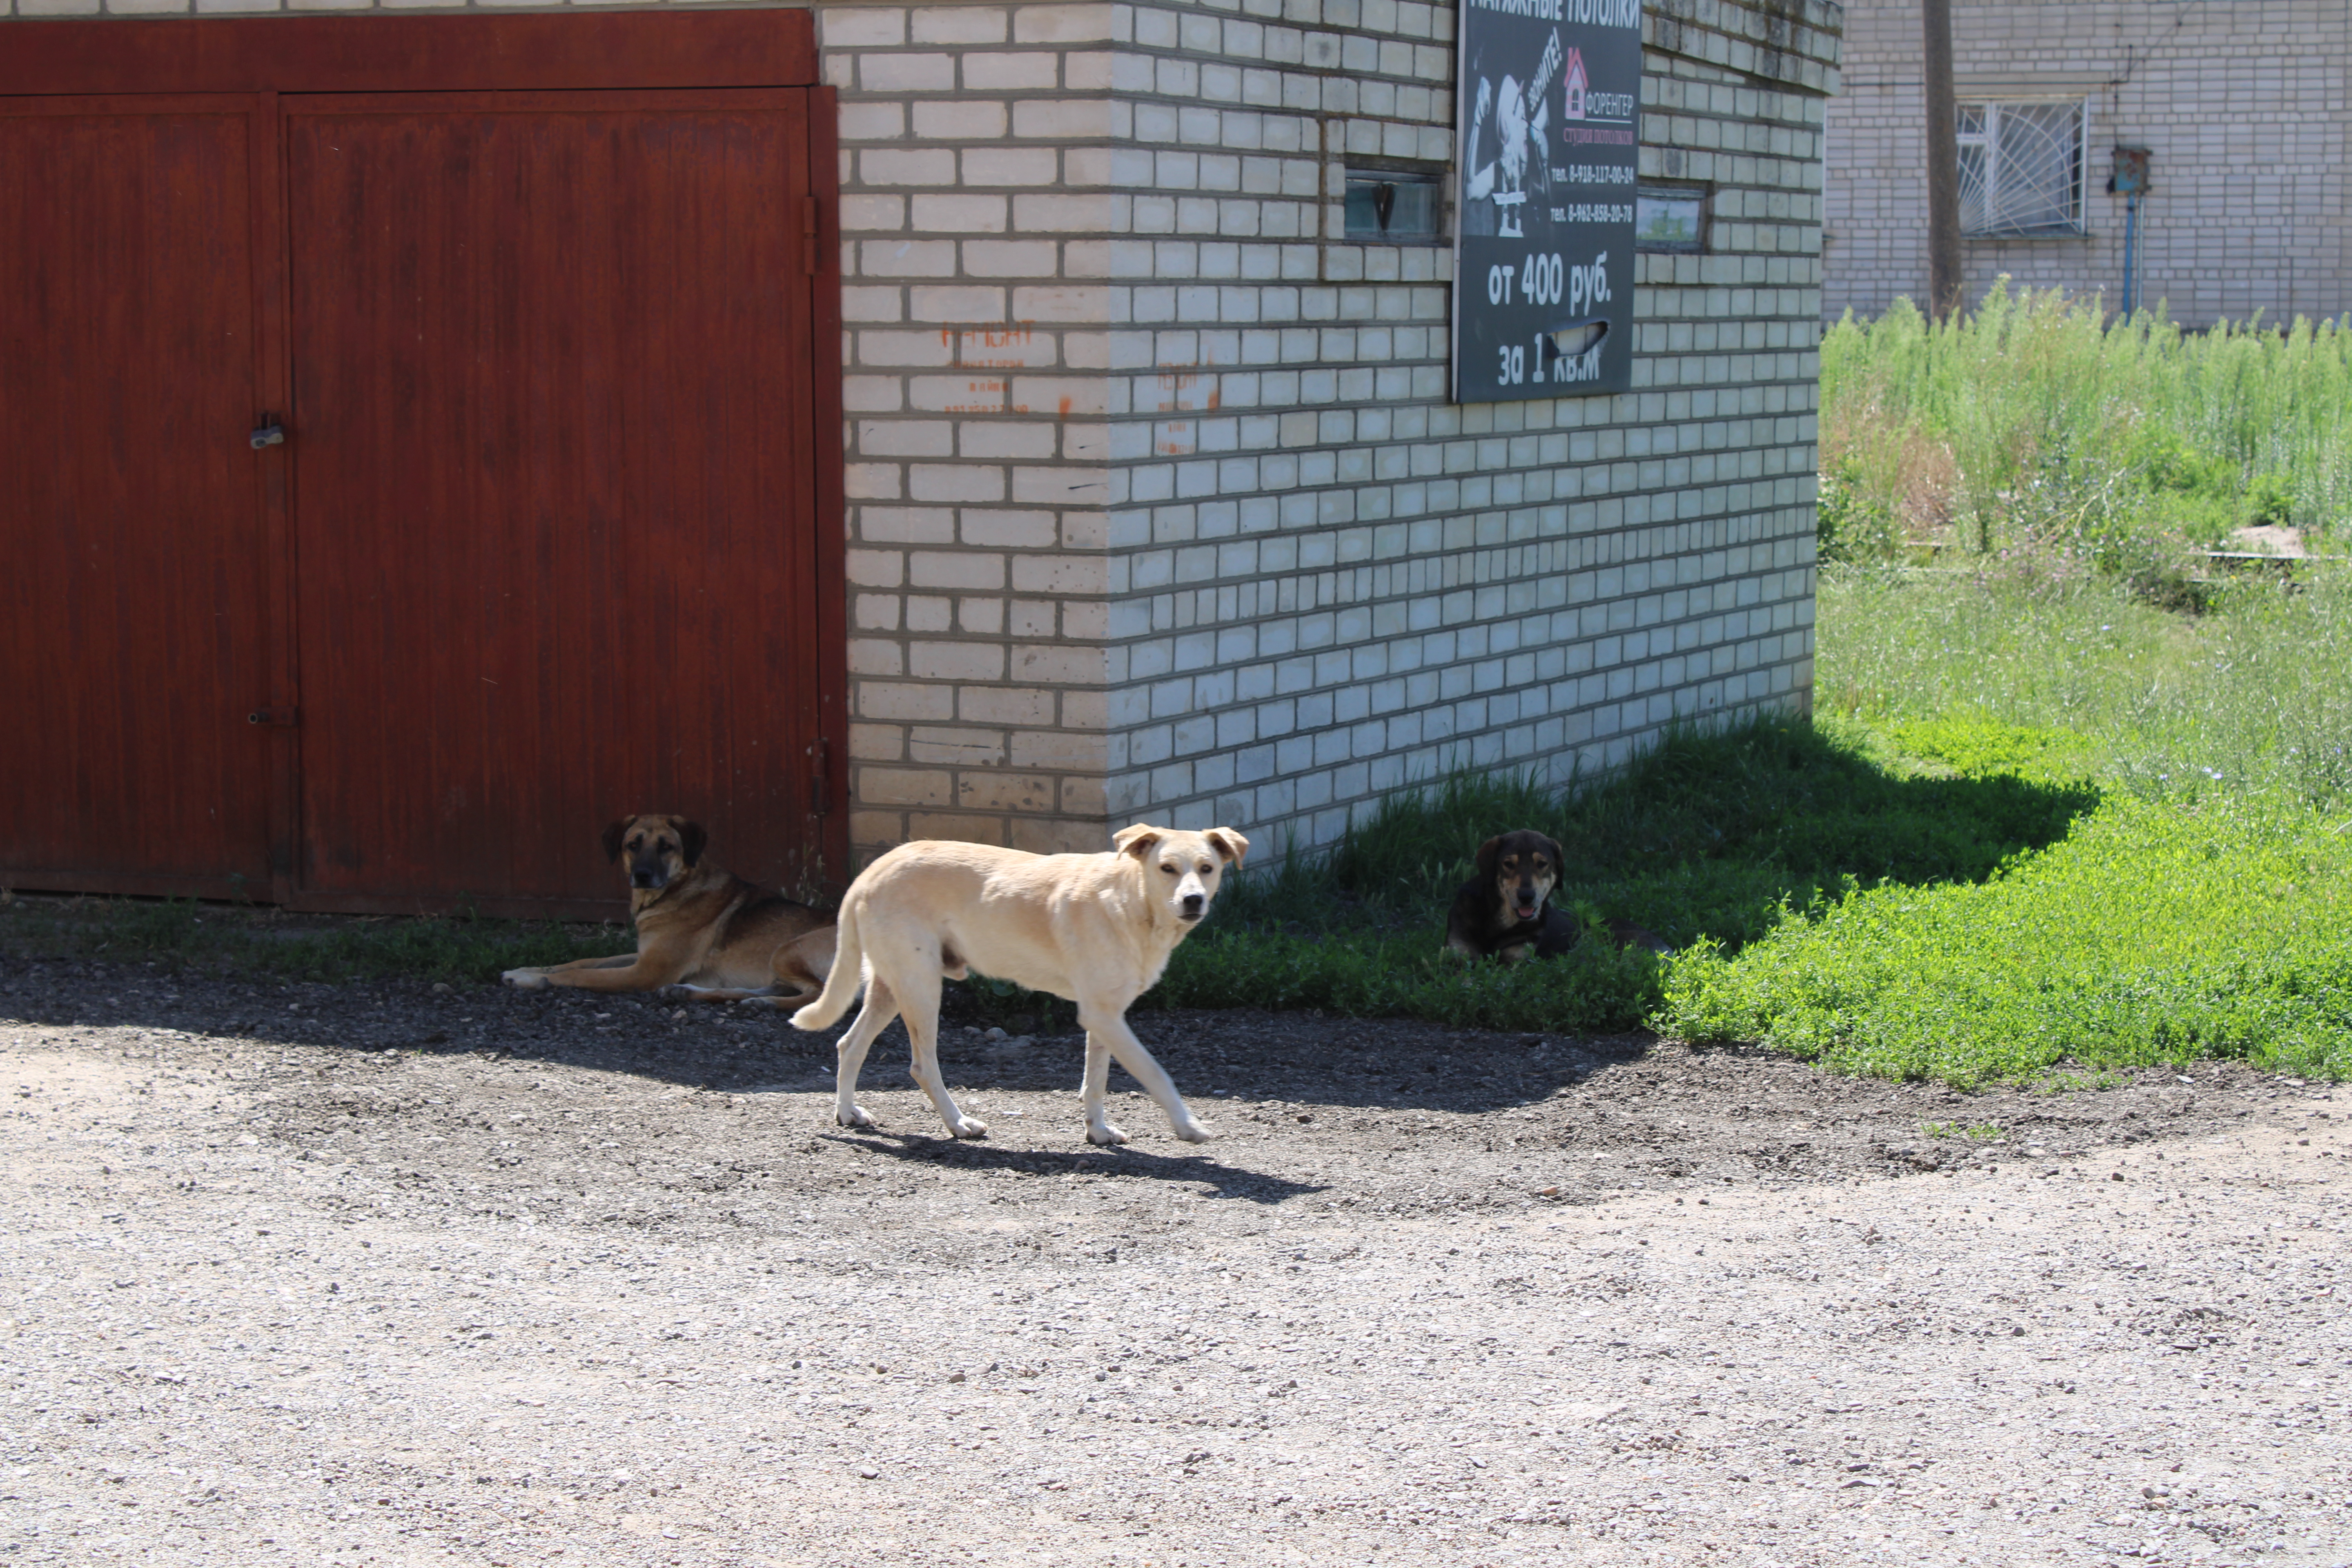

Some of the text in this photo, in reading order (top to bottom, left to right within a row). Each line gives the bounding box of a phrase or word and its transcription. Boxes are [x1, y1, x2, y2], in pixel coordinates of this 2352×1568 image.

[1471, 0, 1639, 29] ЖНЫЕ ПОТОЛКИ
[1586, 91, 1633, 116] ФОРЕНГЕР
[1563, 127, 1633, 147] СТУДИЯ ПОТОЛКОВ
[1551, 164, 1634, 184] тел. 8-918-117-00-24
[1550, 203, 1633, 223] тел. 8-962-858-20-78
[1488, 250, 1612, 317] от 400 руб.
[1498, 345, 1524, 386] за
[1532, 332, 1545, 383] 1
